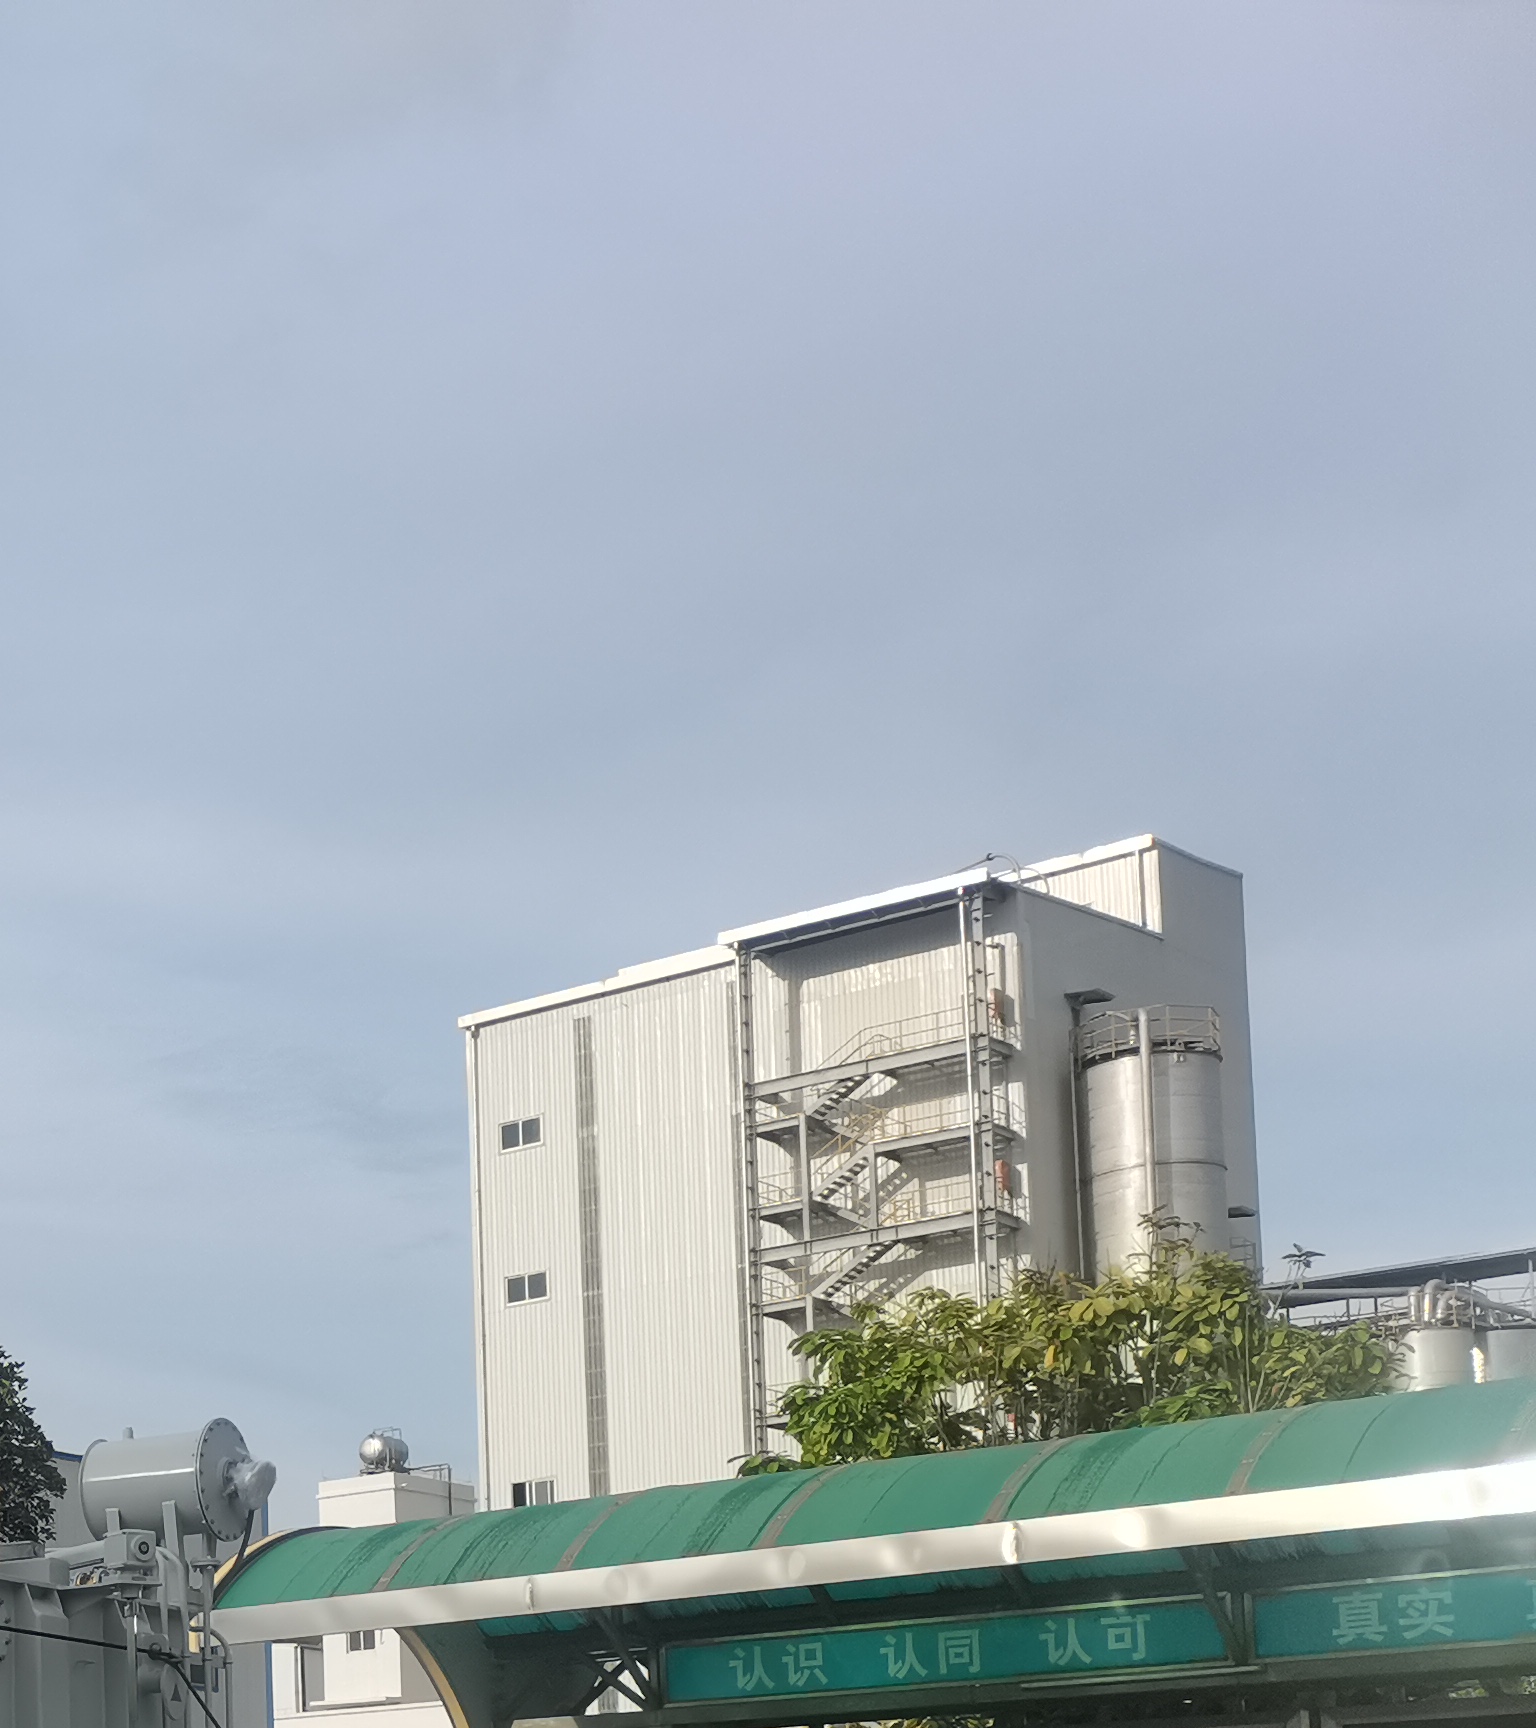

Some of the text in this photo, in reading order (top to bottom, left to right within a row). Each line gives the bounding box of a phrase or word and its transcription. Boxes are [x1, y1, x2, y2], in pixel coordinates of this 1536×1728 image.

[1332, 1586, 1455, 1646] 真实
[728, 1613, 1151, 1692] 认识 认同 认可
